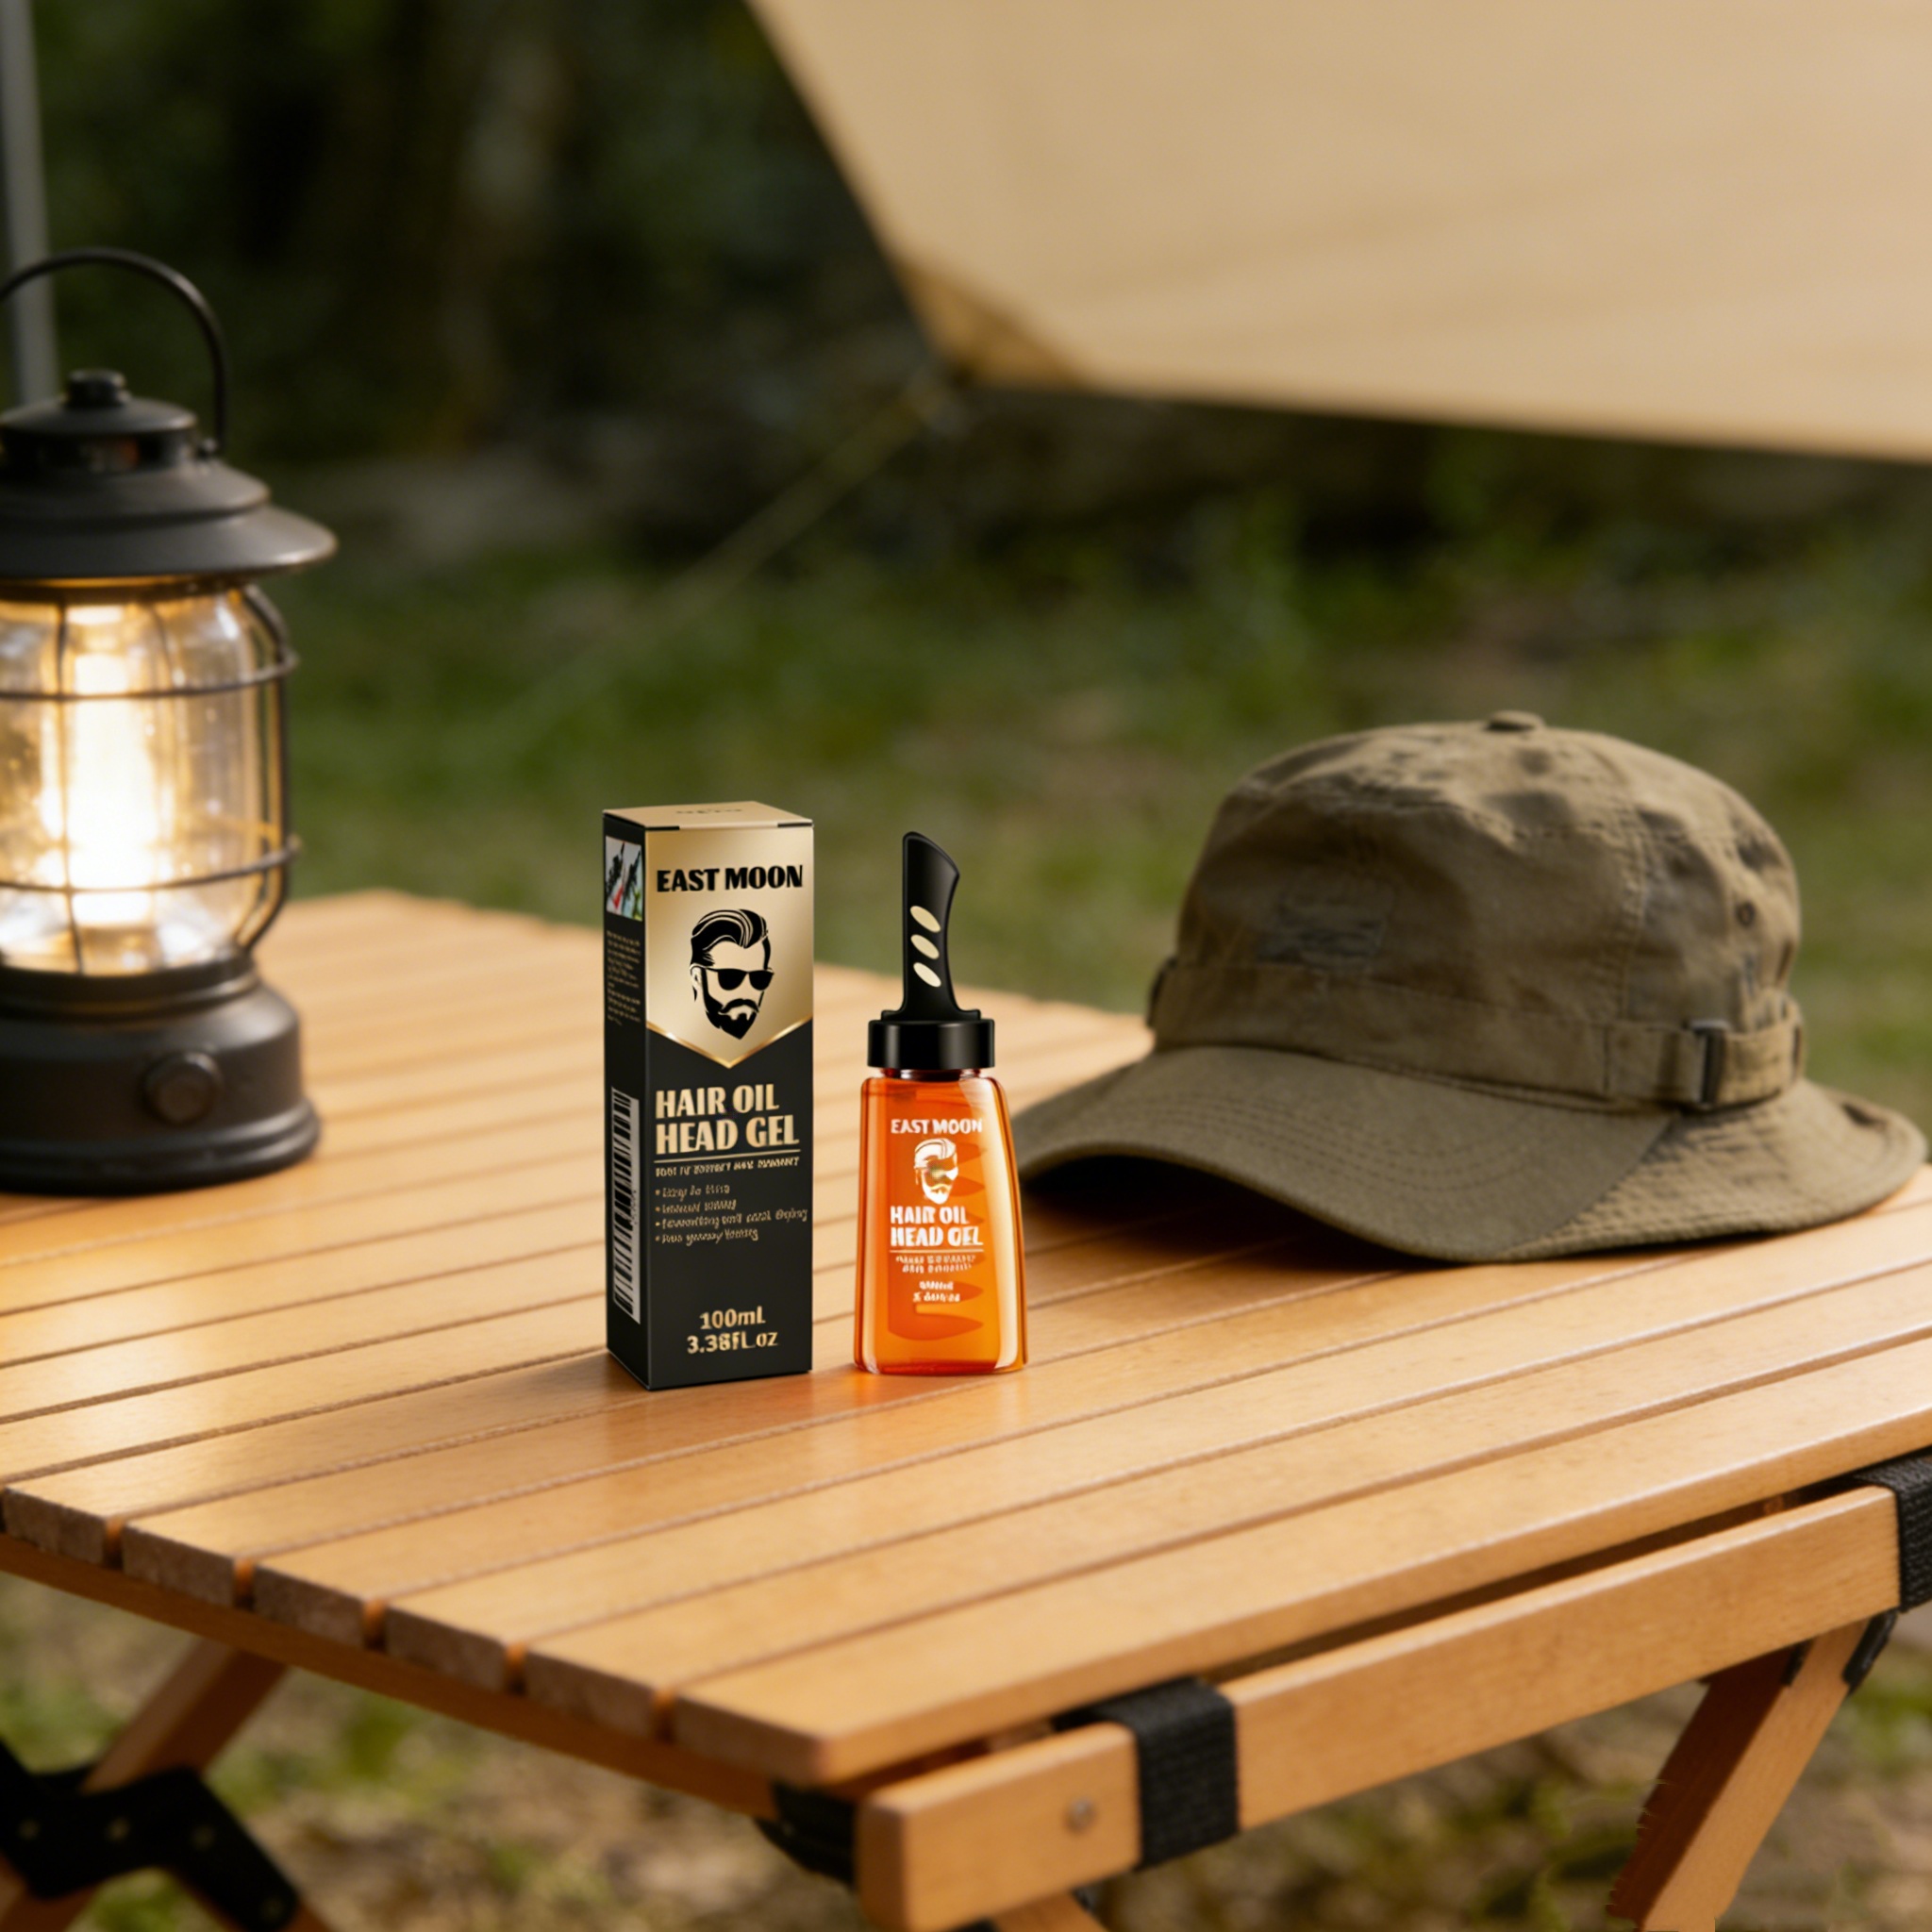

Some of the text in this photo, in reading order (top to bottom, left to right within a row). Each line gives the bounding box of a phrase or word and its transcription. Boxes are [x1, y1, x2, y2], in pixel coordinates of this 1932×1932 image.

[657, 864, 804, 893] EAST MOON
[656, 1083, 780, 1120] HAIR OIL
[656, 1114, 800, 1156] HEAD GEL
[891, 1118, 983, 1135] EAST MOON
[891, 1205, 970, 1224] HAIR OIL
[891, 1225, 944, 1247] HEAD
